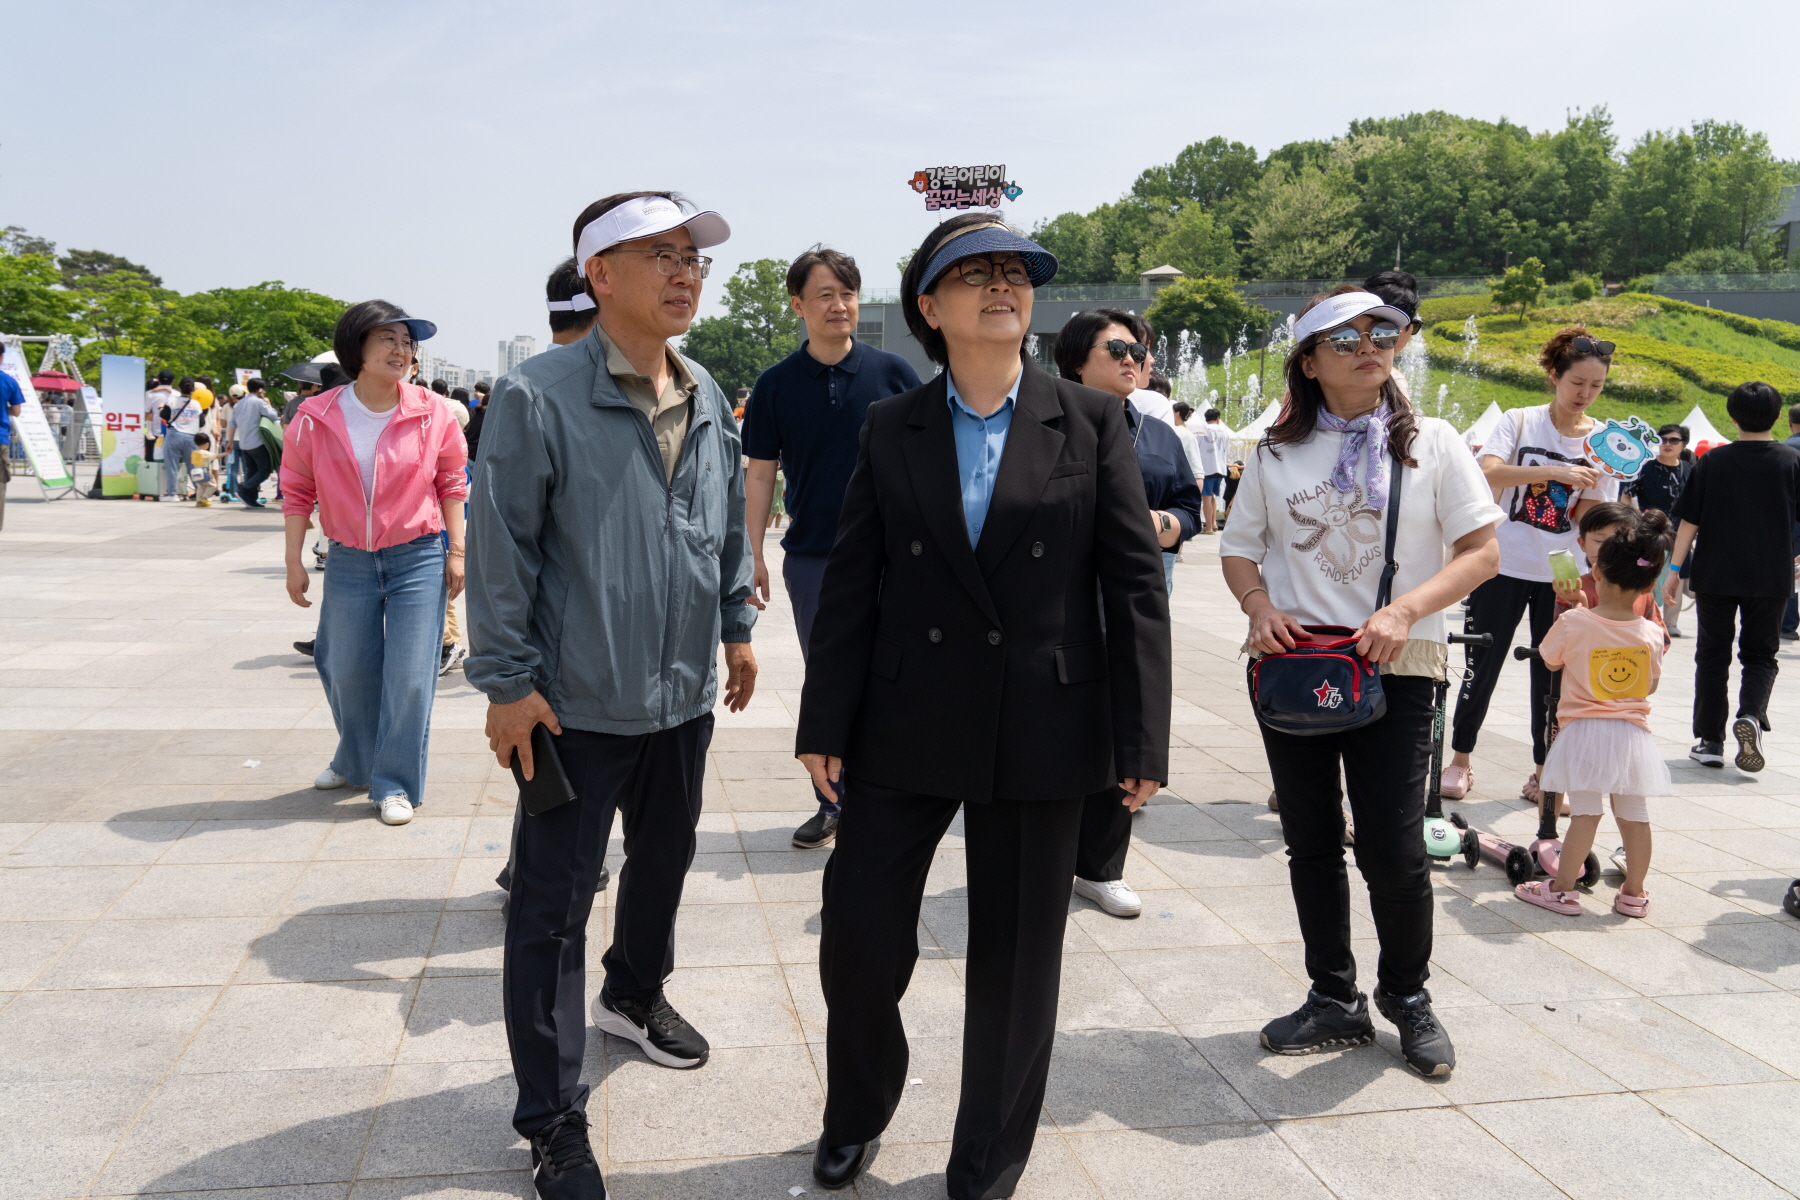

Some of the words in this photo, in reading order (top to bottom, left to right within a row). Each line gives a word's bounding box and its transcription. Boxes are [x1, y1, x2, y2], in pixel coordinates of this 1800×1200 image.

[926, 165, 1005, 189] 강북어린이
[105, 412, 141, 432] 입구
[1291, 511, 1317, 525] MILANO
[1313, 546, 1382, 585] RENDEZVOUS
